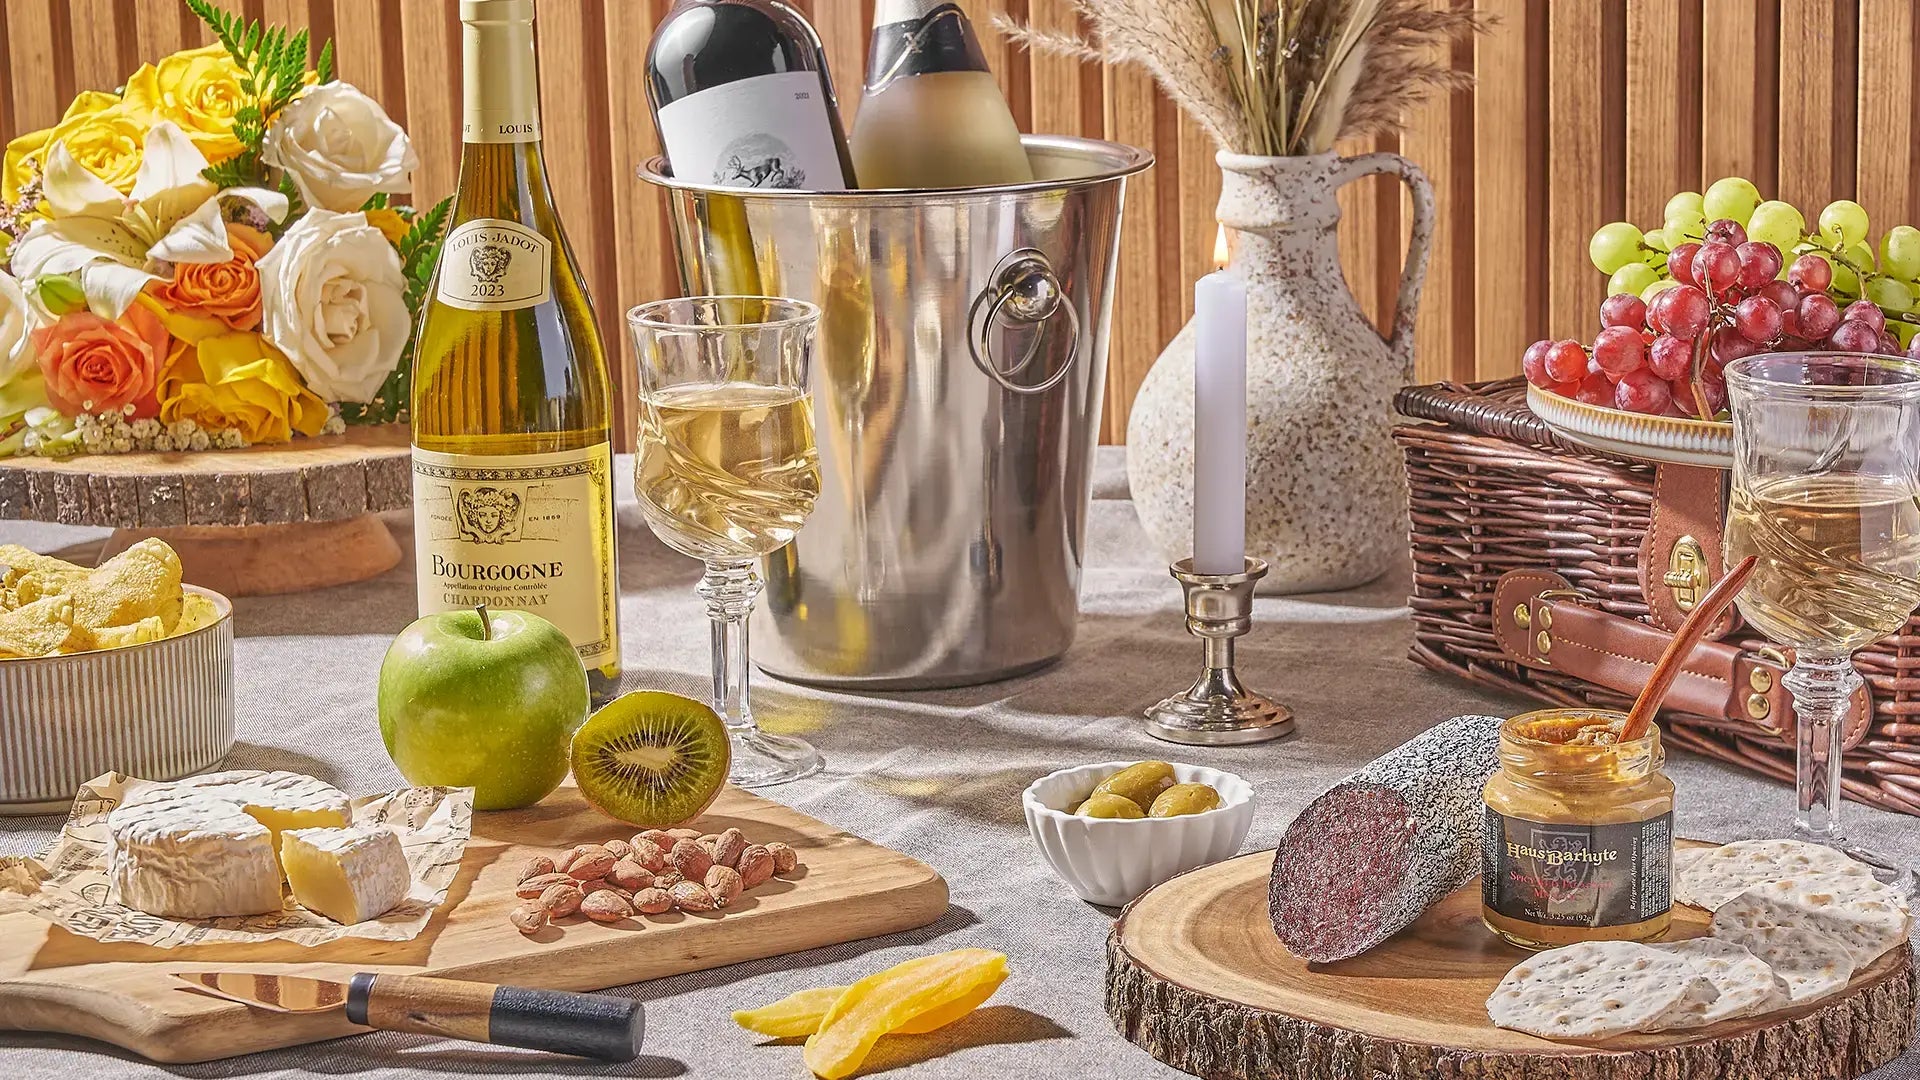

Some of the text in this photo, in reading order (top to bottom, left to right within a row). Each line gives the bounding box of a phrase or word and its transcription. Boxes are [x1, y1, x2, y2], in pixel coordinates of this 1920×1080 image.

[499, 124, 533, 134] LOUIS
[452, 232, 539, 253] LOUIS JADOT
[470, 284, 505, 297] 2023
[431, 554, 563, 581] BOURGOGNE
[443, 581, 548, 593] Appellation d'Origine Contrôlée
[443, 593, 549, 607] CHARDONNAY
[1630, 860, 1638, 877] After
[1630, 878, 1638, 911] Refrigerate
[1524, 908, 1536, 917] Net
